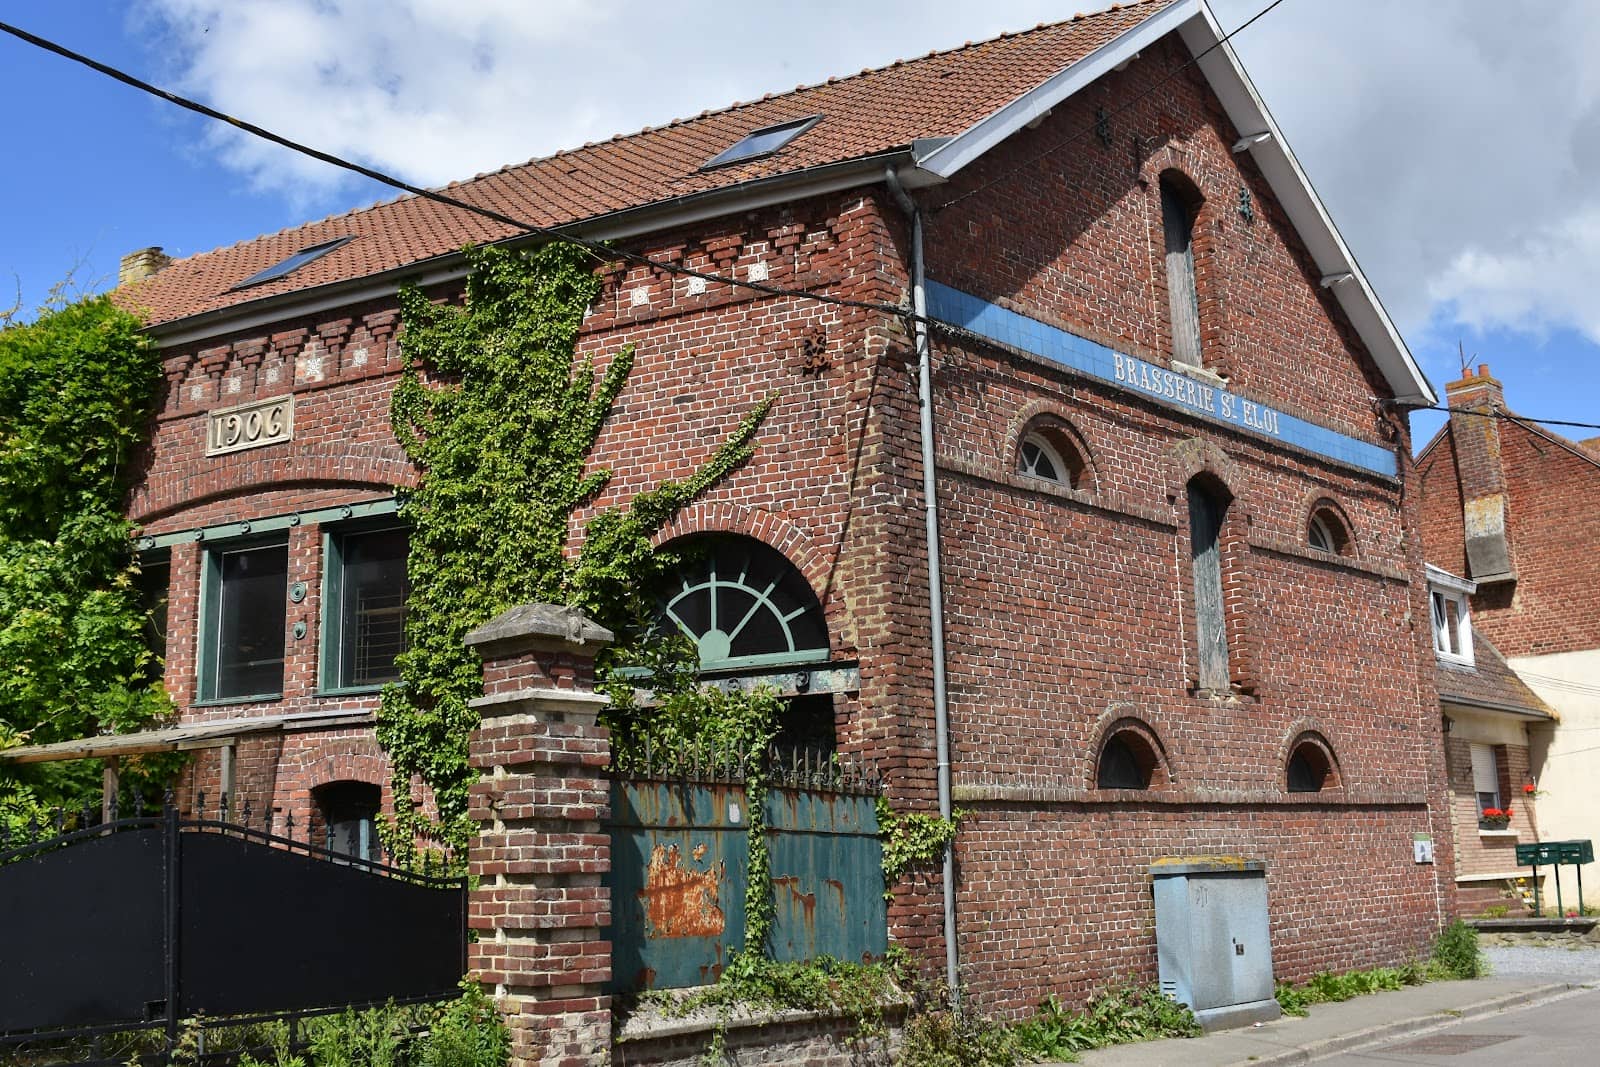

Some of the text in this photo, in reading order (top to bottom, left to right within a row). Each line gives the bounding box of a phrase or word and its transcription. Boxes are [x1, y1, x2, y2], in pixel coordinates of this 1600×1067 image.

[1113, 353, 1215, 413] BRASSERIE
[1242, 400, 1280, 435] ELOI
[215, 405, 283, 449] 1906
